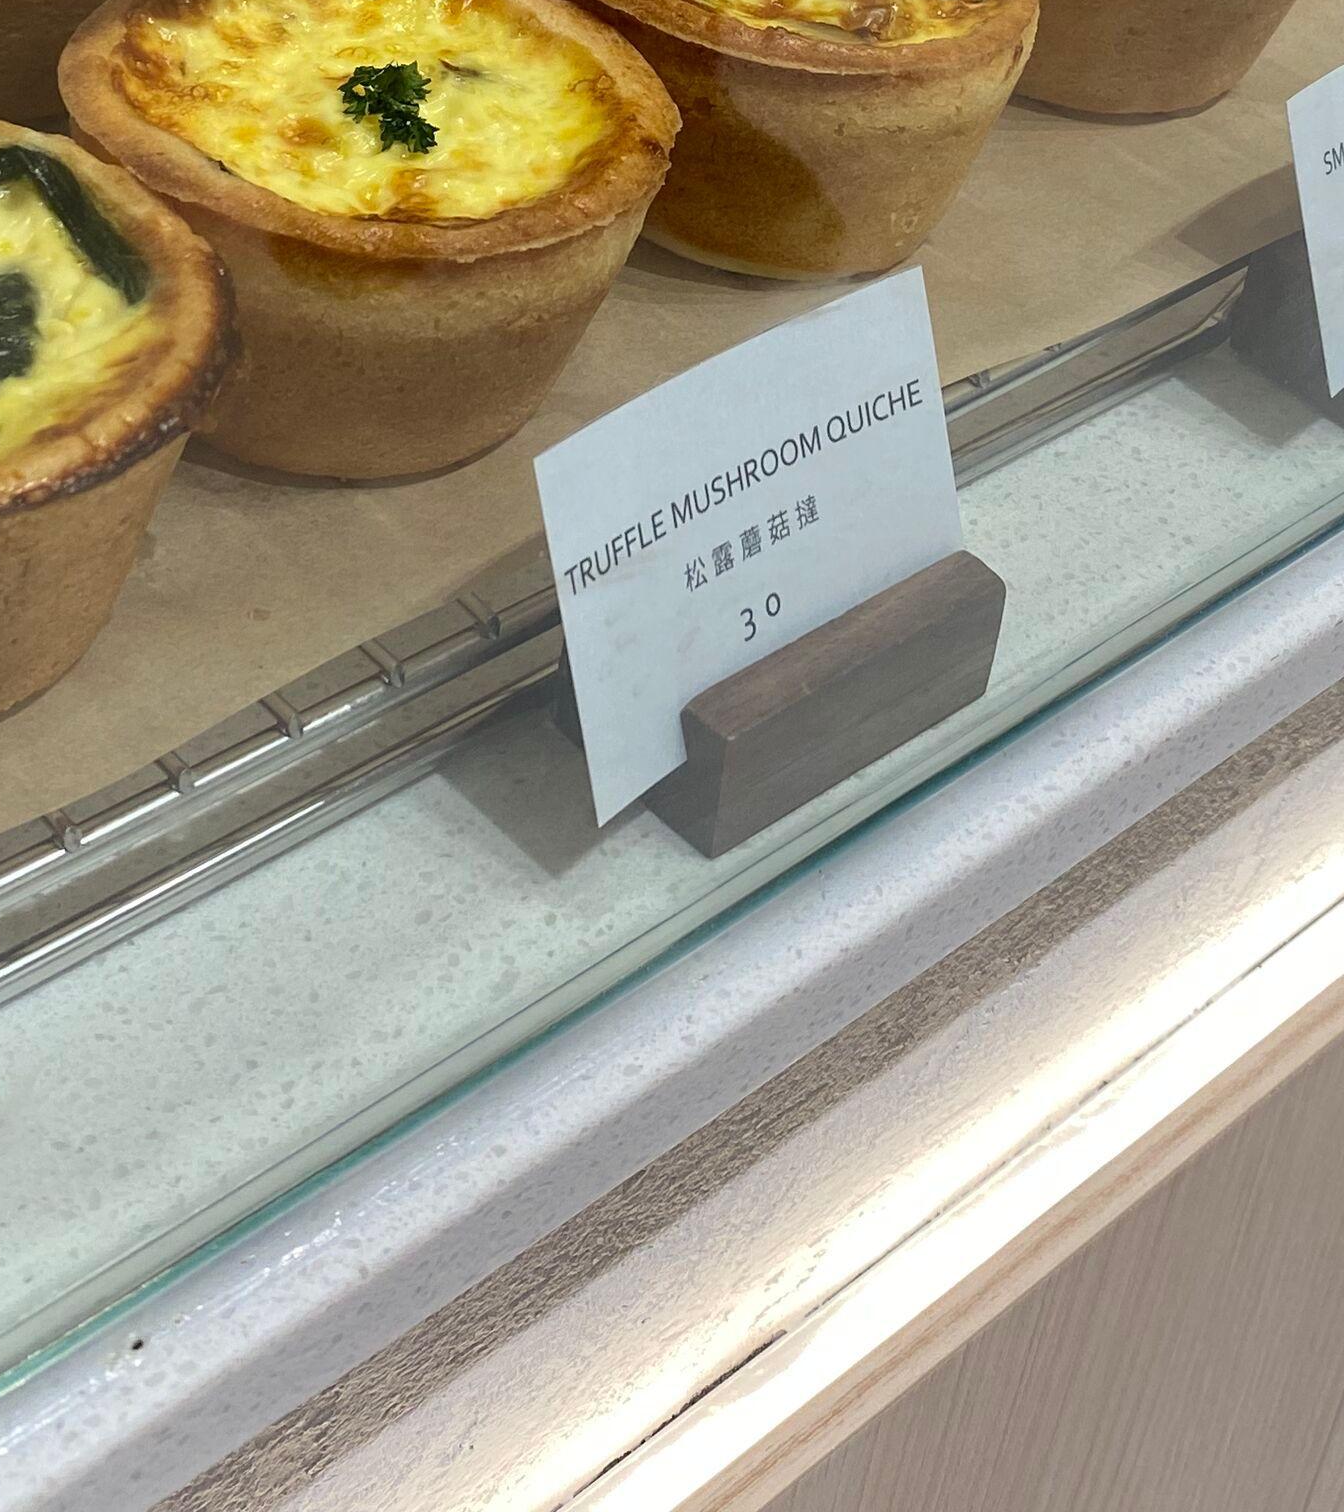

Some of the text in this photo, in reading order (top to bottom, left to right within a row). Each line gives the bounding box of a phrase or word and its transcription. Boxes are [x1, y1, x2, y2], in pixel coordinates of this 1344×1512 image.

[564, 379, 924, 597] TRUFFLE MUSHROOM QUICHE
[683, 494, 820, 593] 松露蘑菇撻
